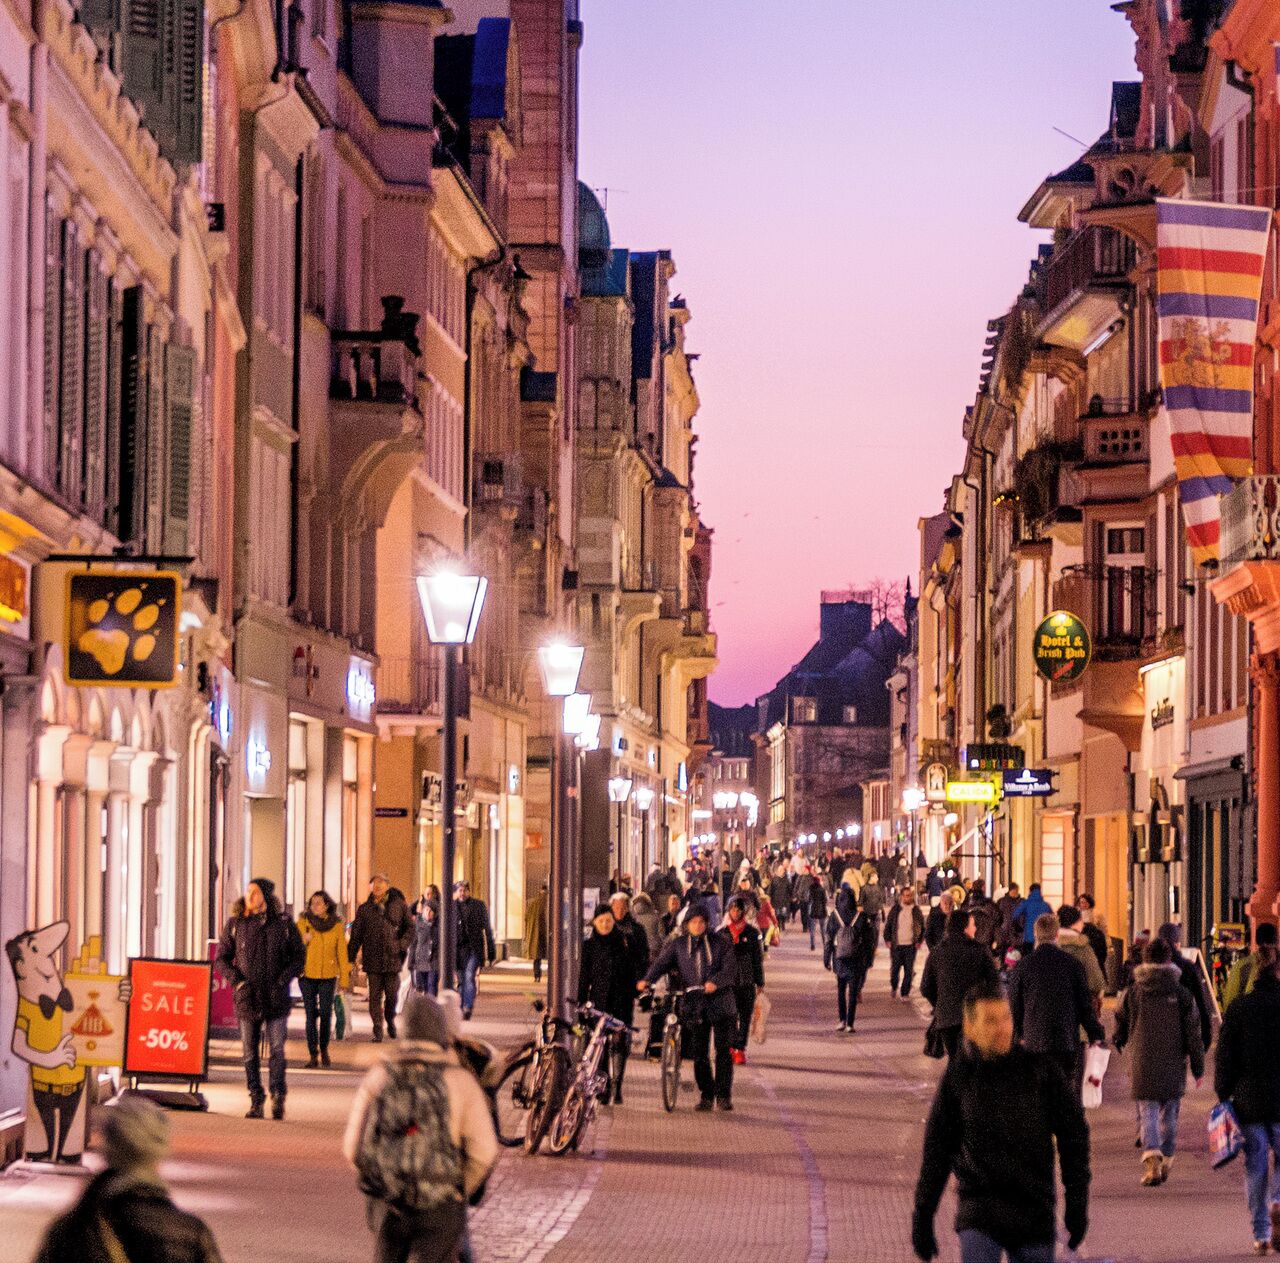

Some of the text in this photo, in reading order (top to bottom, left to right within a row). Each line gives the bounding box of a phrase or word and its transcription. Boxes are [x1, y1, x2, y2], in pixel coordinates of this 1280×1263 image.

[1040, 635, 1083, 647] Hotel &
[1037, 647, 1086, 660] Irish Pub
[980, 758, 1021, 770] BUTLER
[140, 992, 196, 1016] SALE
[138, 1027, 190, 1052] -50%
